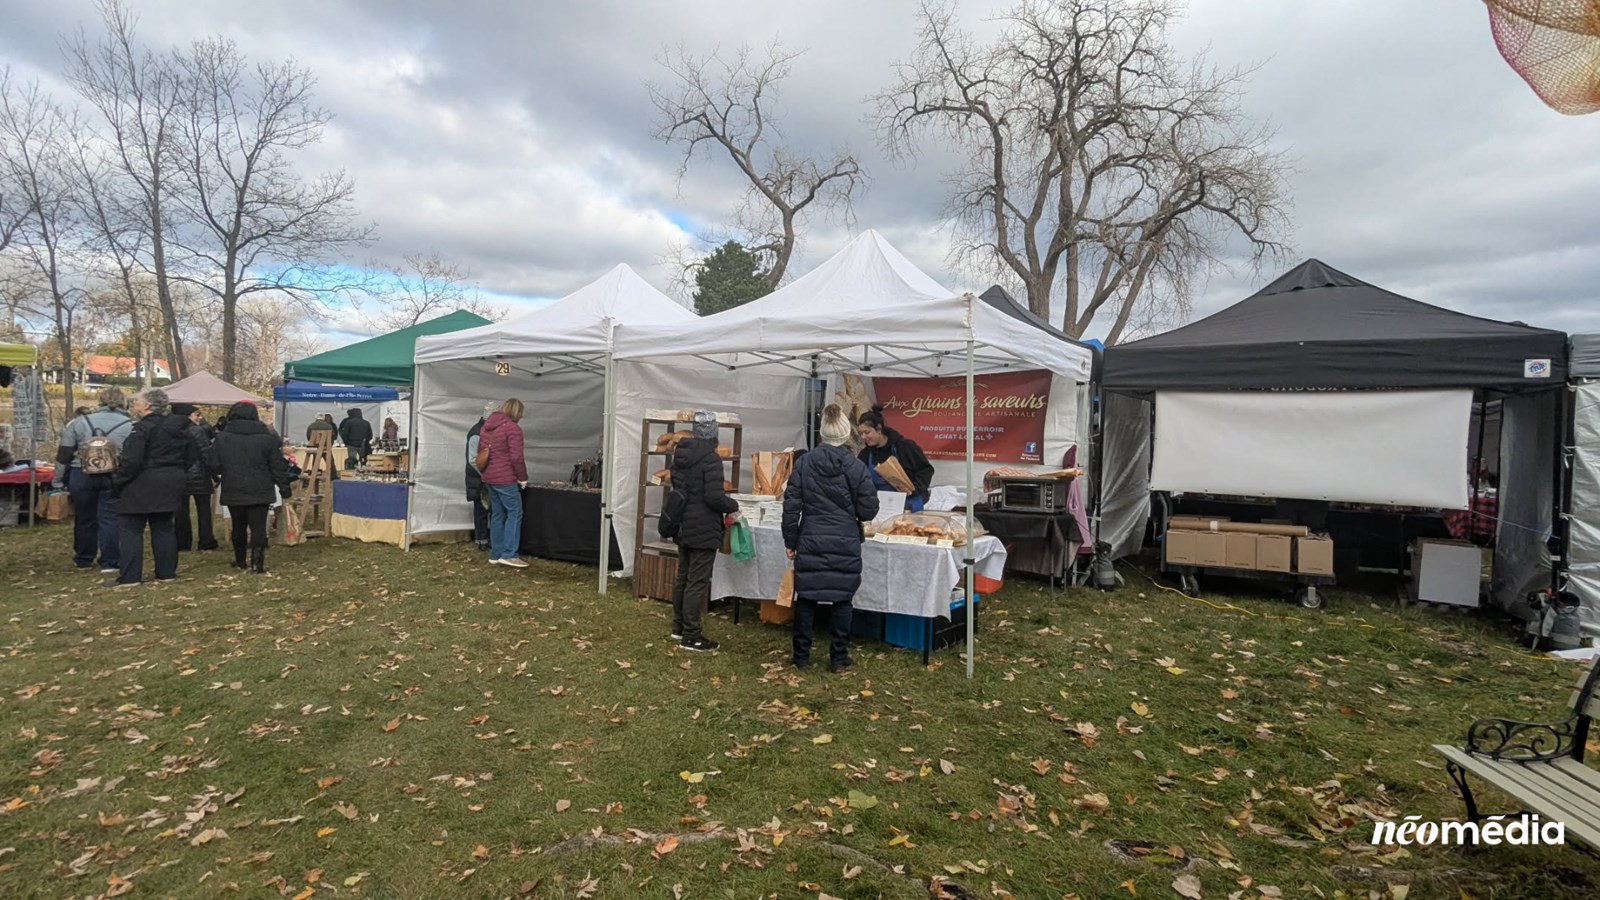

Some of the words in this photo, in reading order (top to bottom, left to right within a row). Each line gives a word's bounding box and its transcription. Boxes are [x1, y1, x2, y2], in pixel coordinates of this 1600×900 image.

[497, 362, 510, 374] 29
[883, 395, 911, 410] Aux
[902, 395, 962, 418] grains
[980, 393, 1047, 409] saveurs
